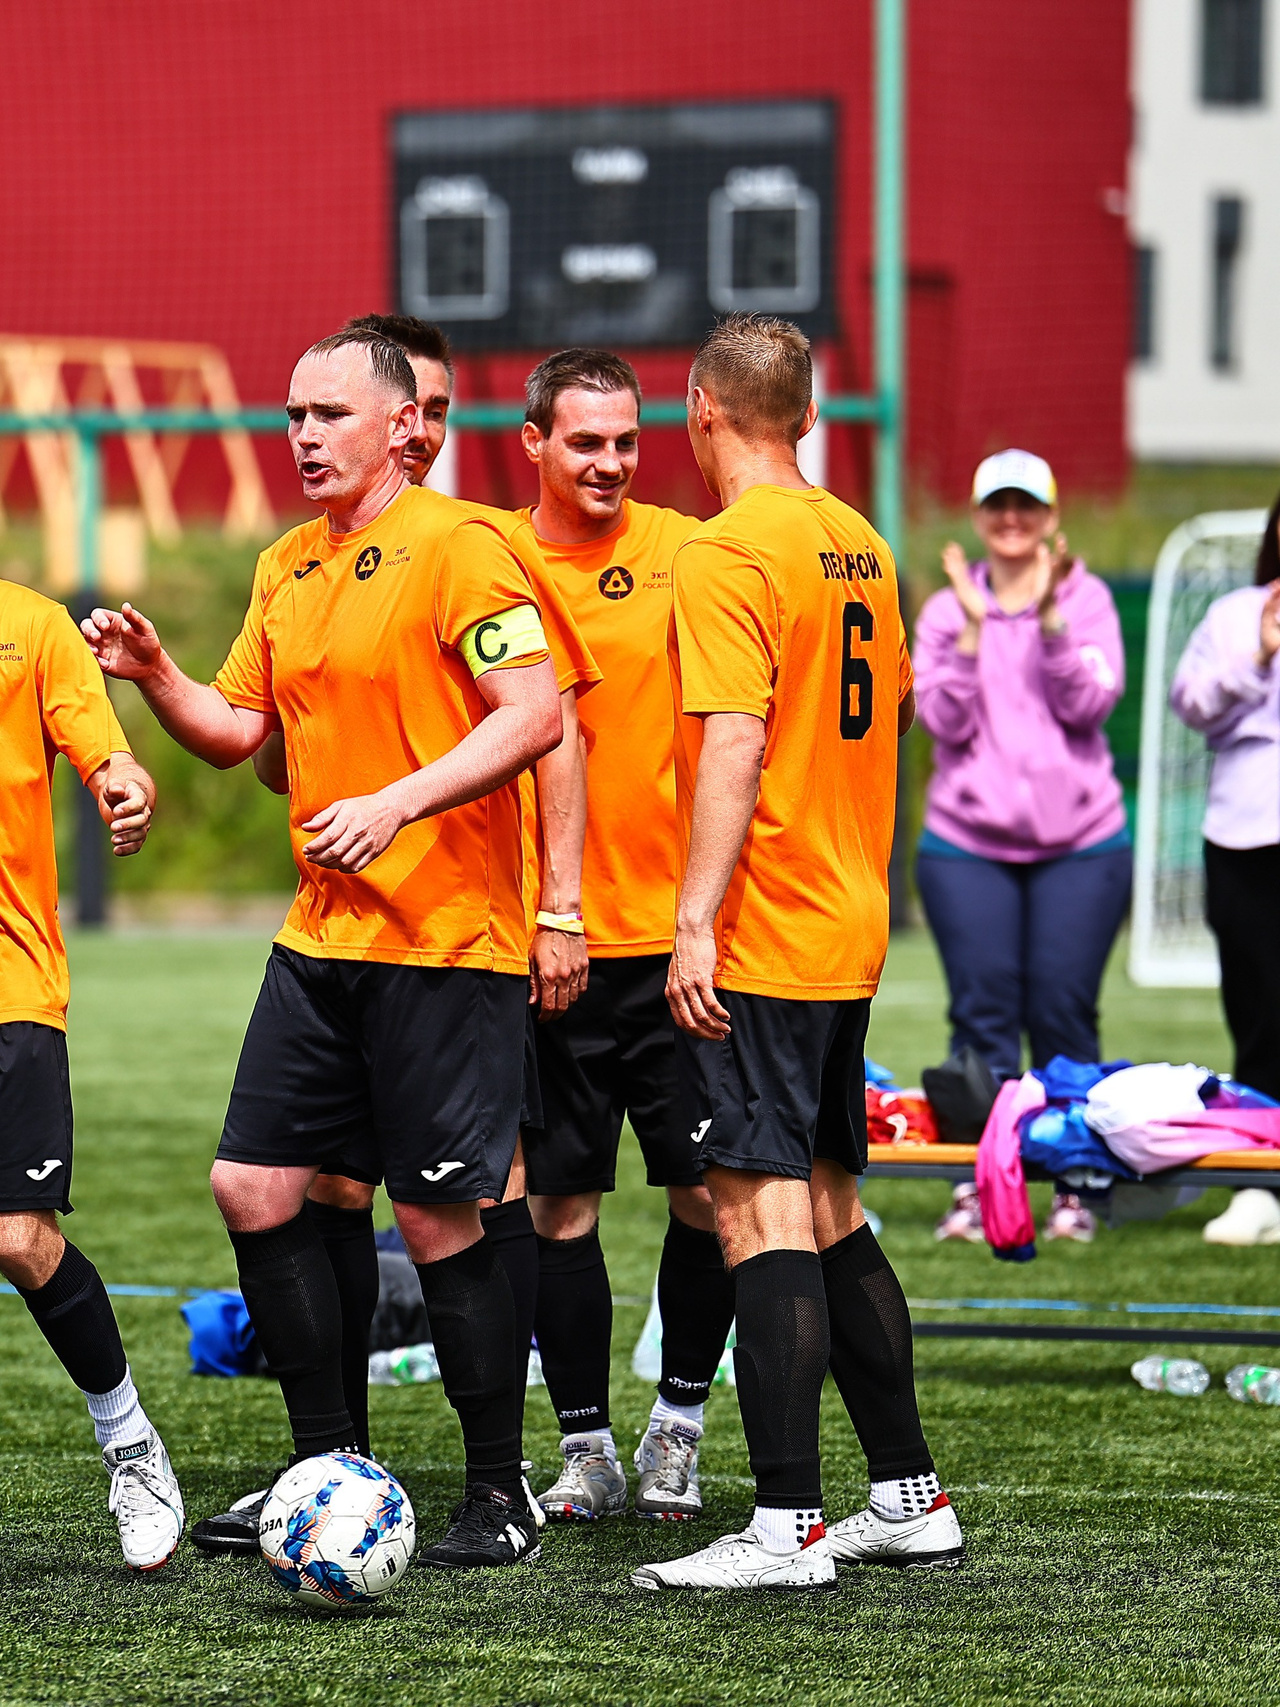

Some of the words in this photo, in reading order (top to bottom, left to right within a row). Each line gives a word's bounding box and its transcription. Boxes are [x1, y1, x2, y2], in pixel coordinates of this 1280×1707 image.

[650, 572, 668, 580] ЭХП
[0, 643, 16, 651] ЭХП
[839, 601, 874, 741] 6
[117, 1443, 147, 1460] Joma
